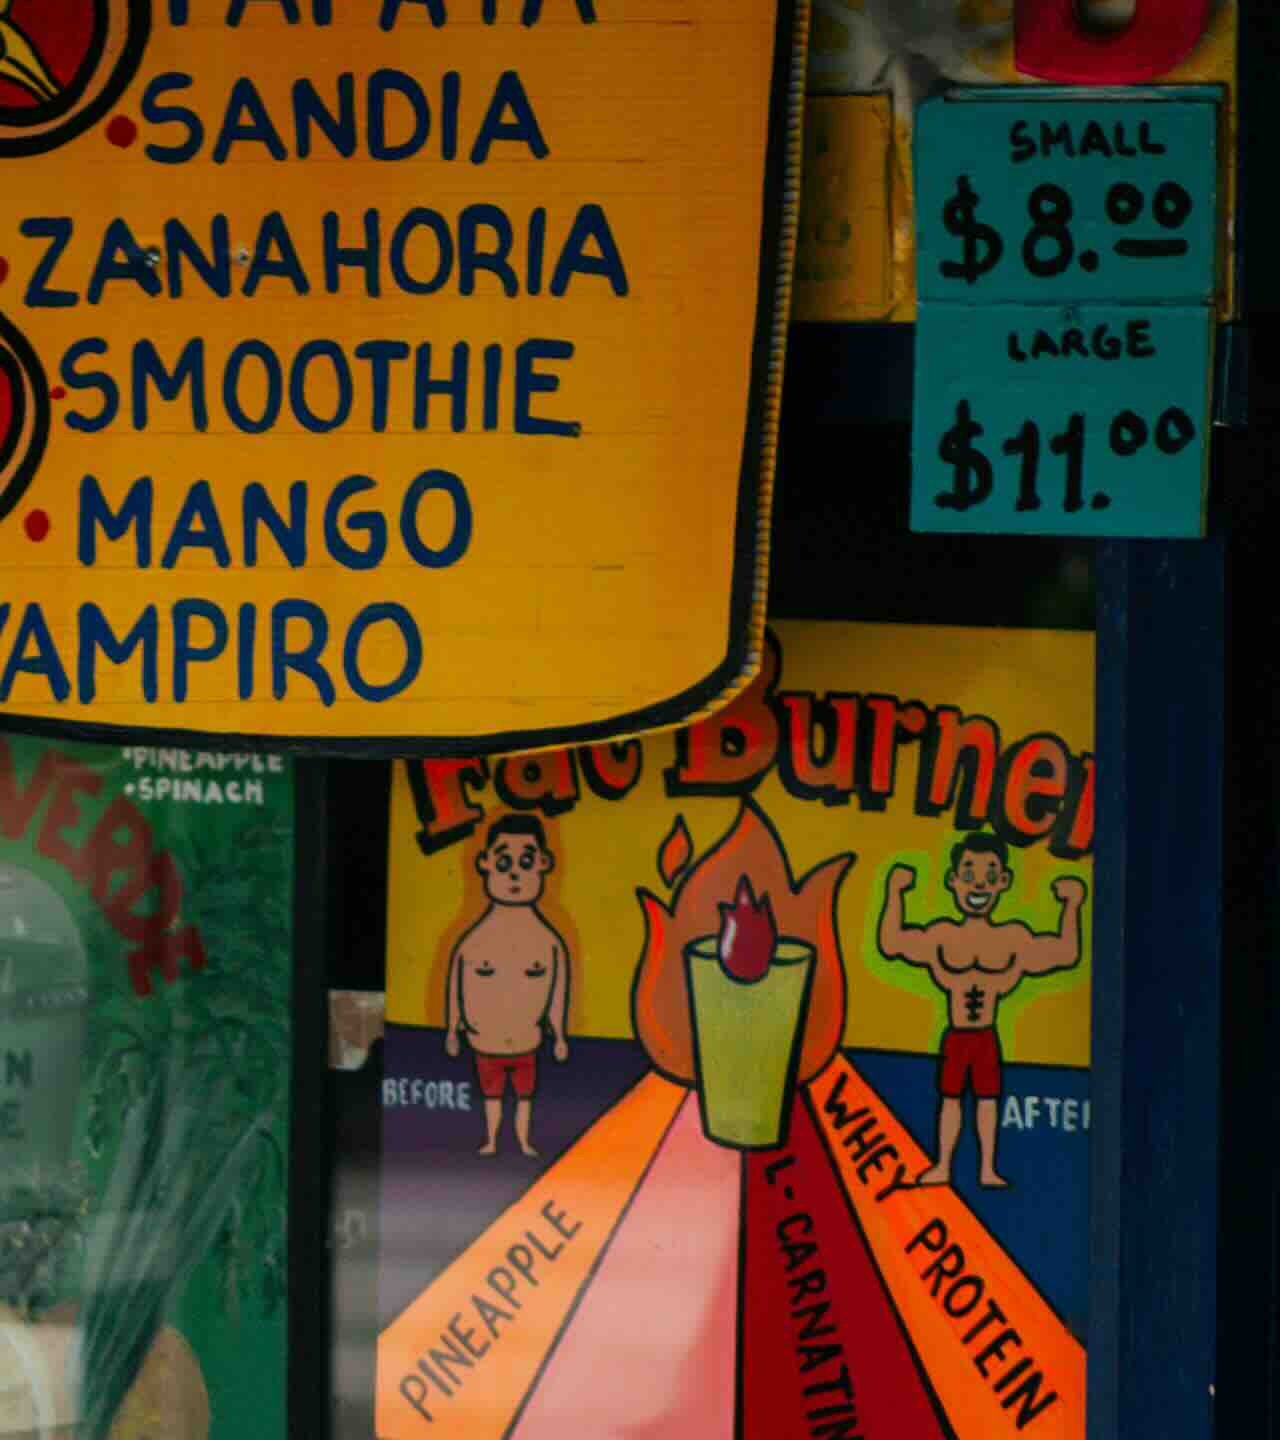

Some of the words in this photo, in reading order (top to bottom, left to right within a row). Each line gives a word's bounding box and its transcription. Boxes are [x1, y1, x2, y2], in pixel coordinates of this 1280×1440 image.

[139, 70, 550, 163] SANDIA
[1008, 120, 1166, 162] SMALL
[18, 203, 631, 308] ZANAHORIA
[938, 175, 1193, 285] $8.00
[62, 337, 582, 438] SMOOTHIE
[1006, 320, 1157, 361] LARGE
[933, 399, 1197, 514] $11.00
[76, 468, 474, 570] MANGO
[139, 777, 264, 806] SPINACH
[381, 1077, 473, 1114] BEFORE
[822, 1071, 920, 1206] WHEY
[396, 1197, 584, 1424] PINEAPPLE
[904, 1217, 1064, 1433] PROTEIN
